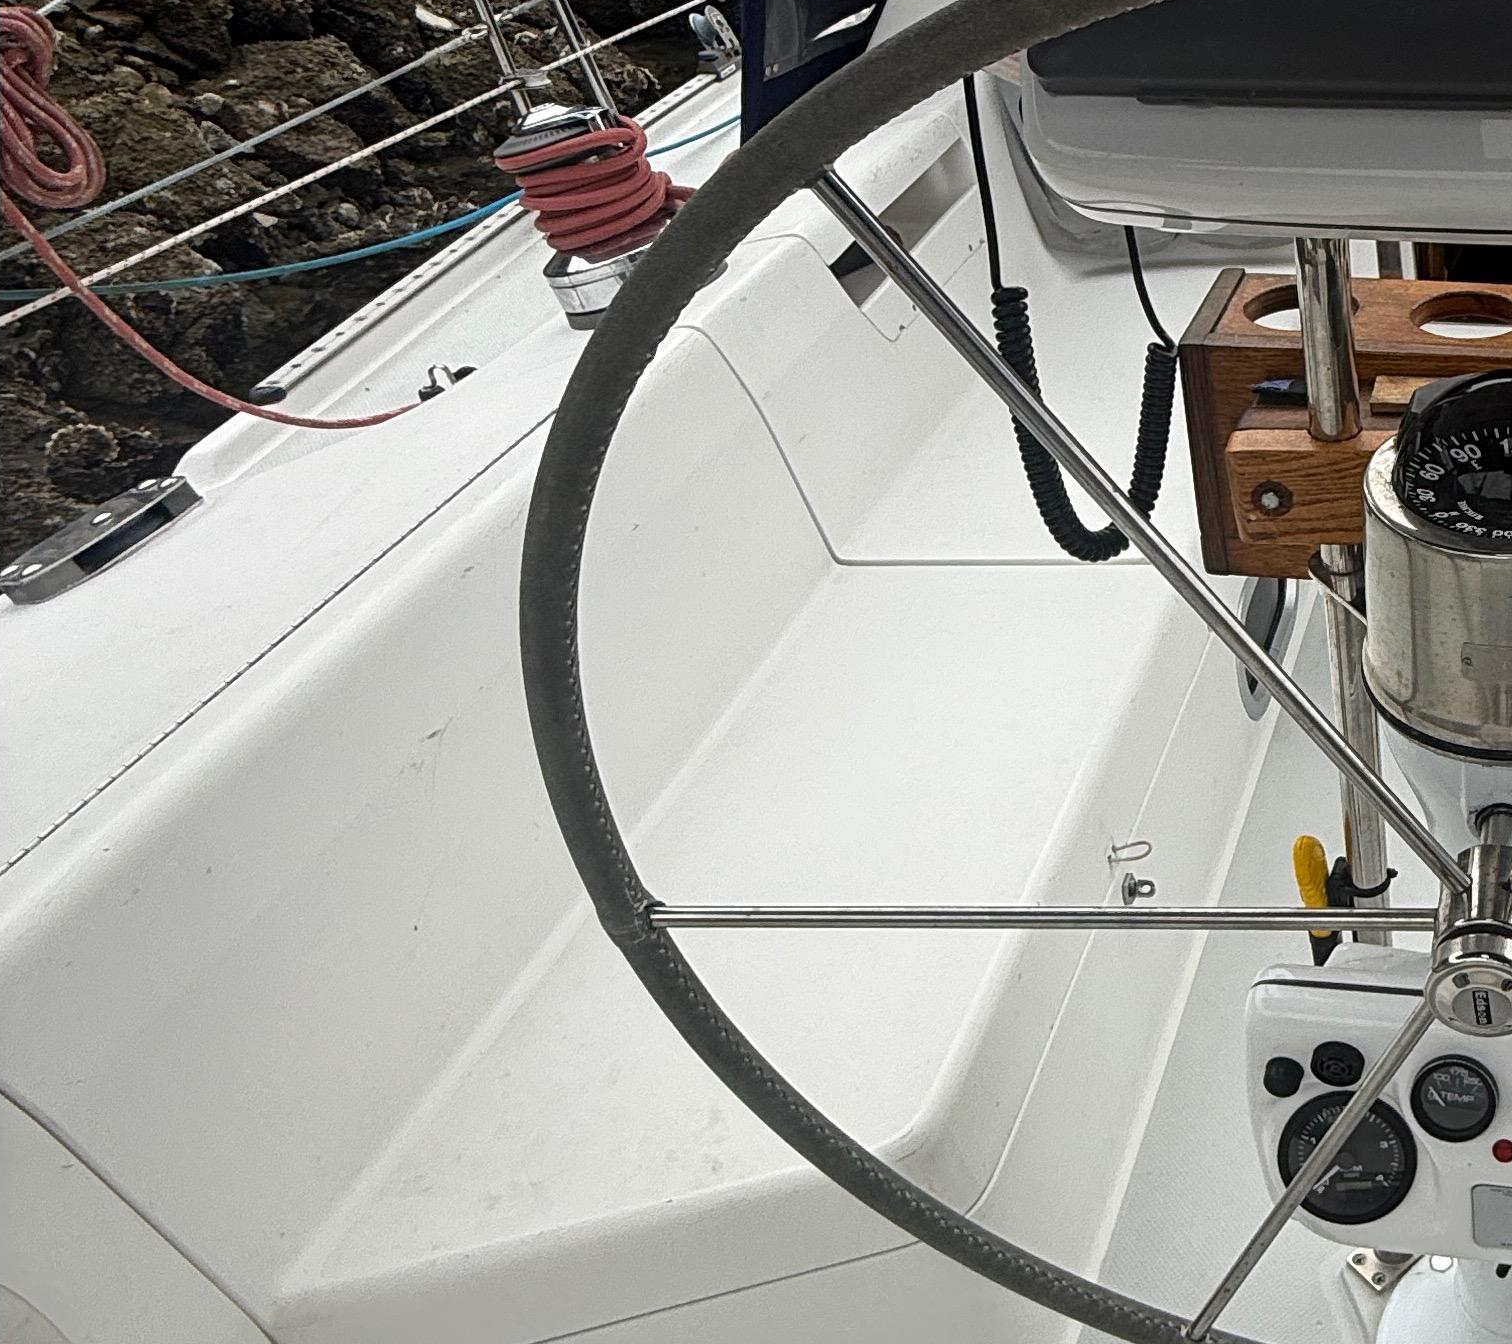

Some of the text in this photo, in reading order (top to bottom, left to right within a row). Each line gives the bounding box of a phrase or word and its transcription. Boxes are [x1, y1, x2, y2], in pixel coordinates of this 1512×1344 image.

[1449, 443, 1482, 463] 90
[1418, 462, 1445, 482] 60
[1441, 1091, 1475, 1103] TEMP
